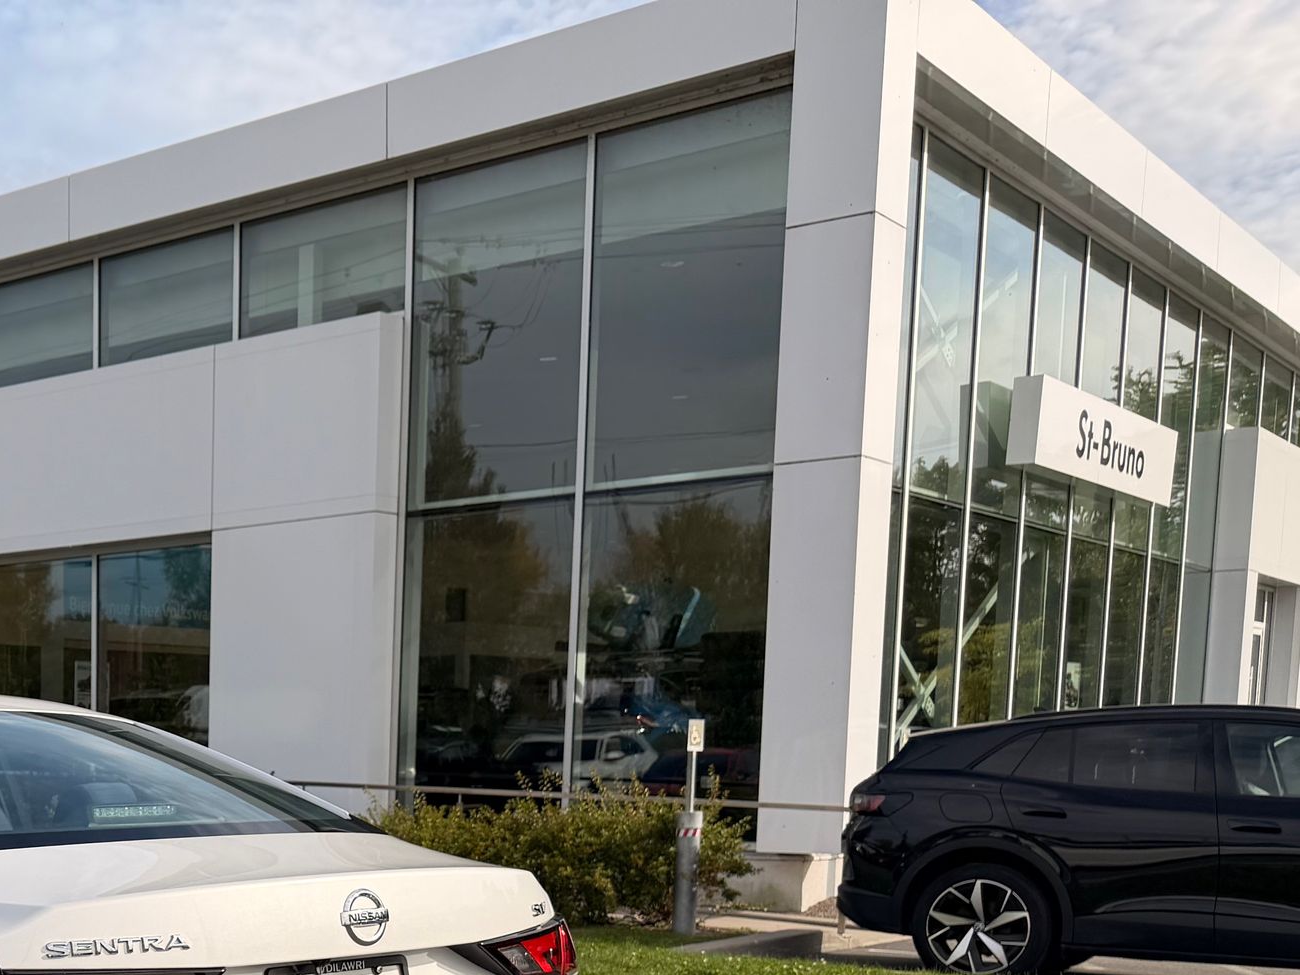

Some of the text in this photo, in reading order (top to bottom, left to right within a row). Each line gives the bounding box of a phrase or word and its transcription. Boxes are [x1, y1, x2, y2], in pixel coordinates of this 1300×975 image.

[1076, 409, 1145, 479] St-Bruno
[348, 910, 387, 923] NISSAN
[43, 935, 190, 958] SENTRA
[325, 960, 366, 974] DILAWRI
